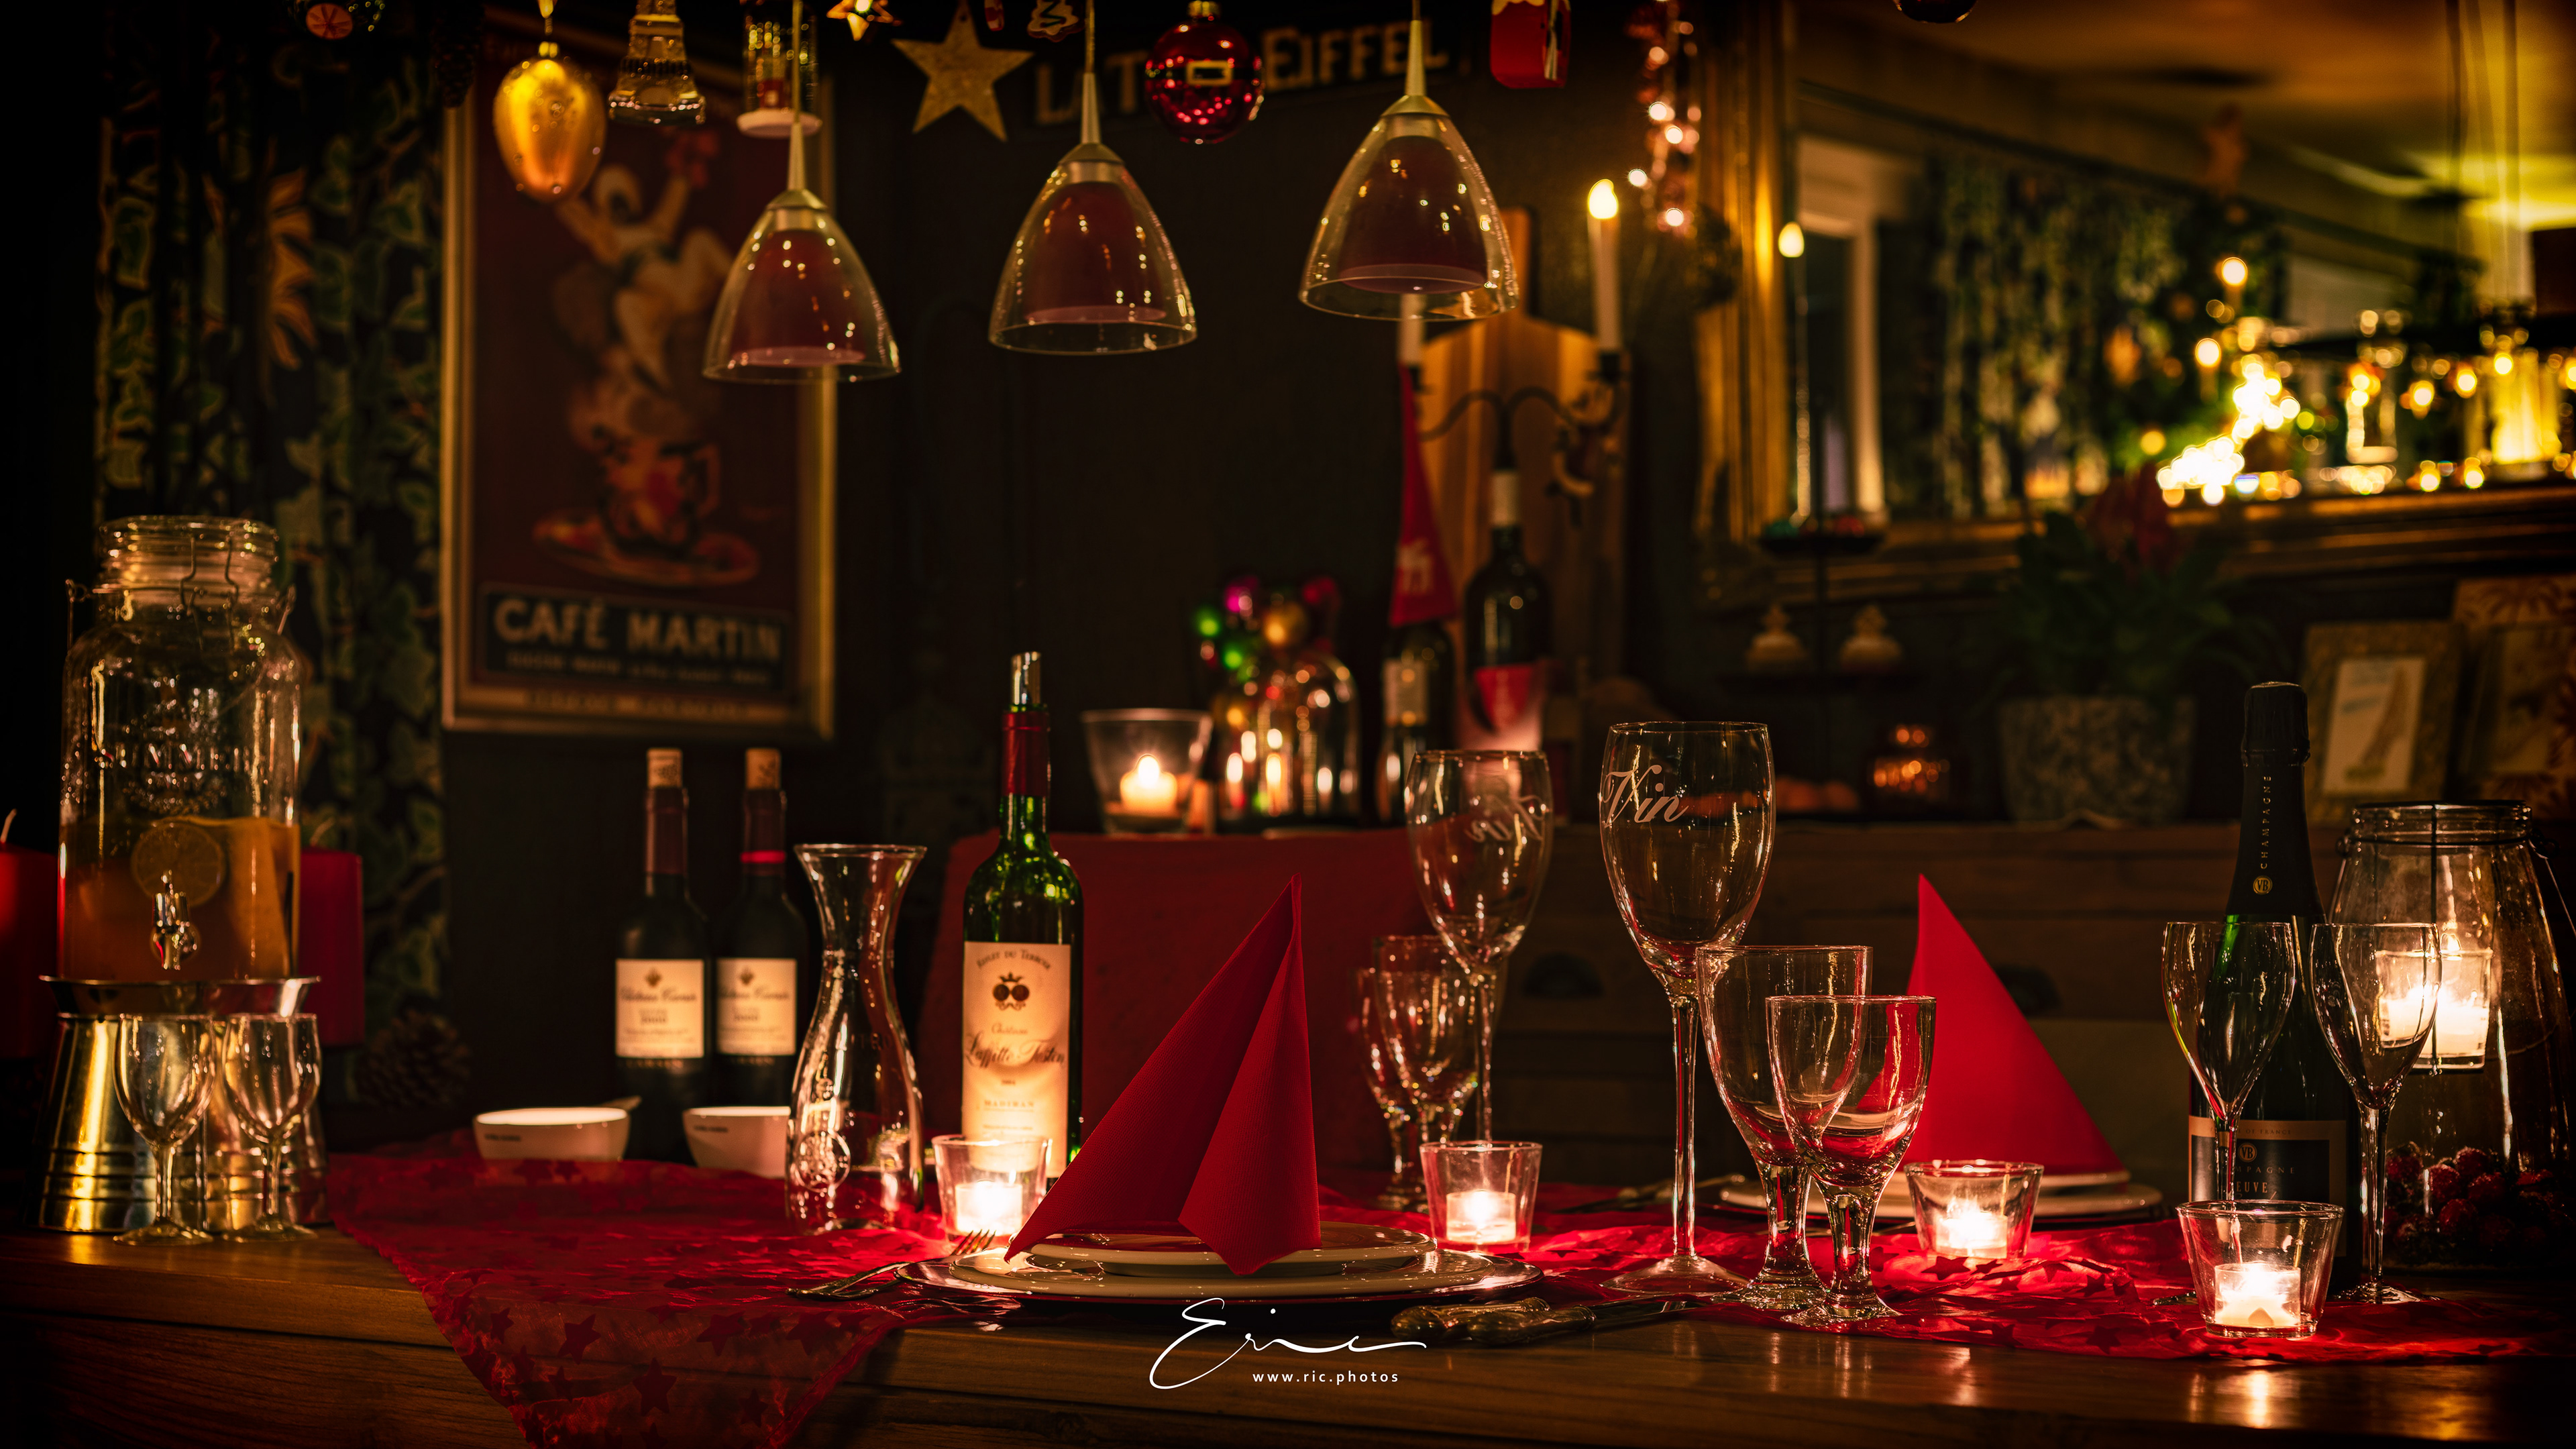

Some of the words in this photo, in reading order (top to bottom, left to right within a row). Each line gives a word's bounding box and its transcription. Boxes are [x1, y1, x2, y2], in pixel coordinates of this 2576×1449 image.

[1261, 16, 1450, 91] EIFFEL
[494, 596, 610, 651] CAFÉ
[626, 611, 782, 663] MARTIN
[1603, 764, 1689, 828] Vin
[2260, 775, 2271, 869] CHAMPAGNE
[2257, 879, 2269, 892] VB
[2241, 1147, 2253, 1159] VB
[2236, 1181, 2268, 1193] EUVE
